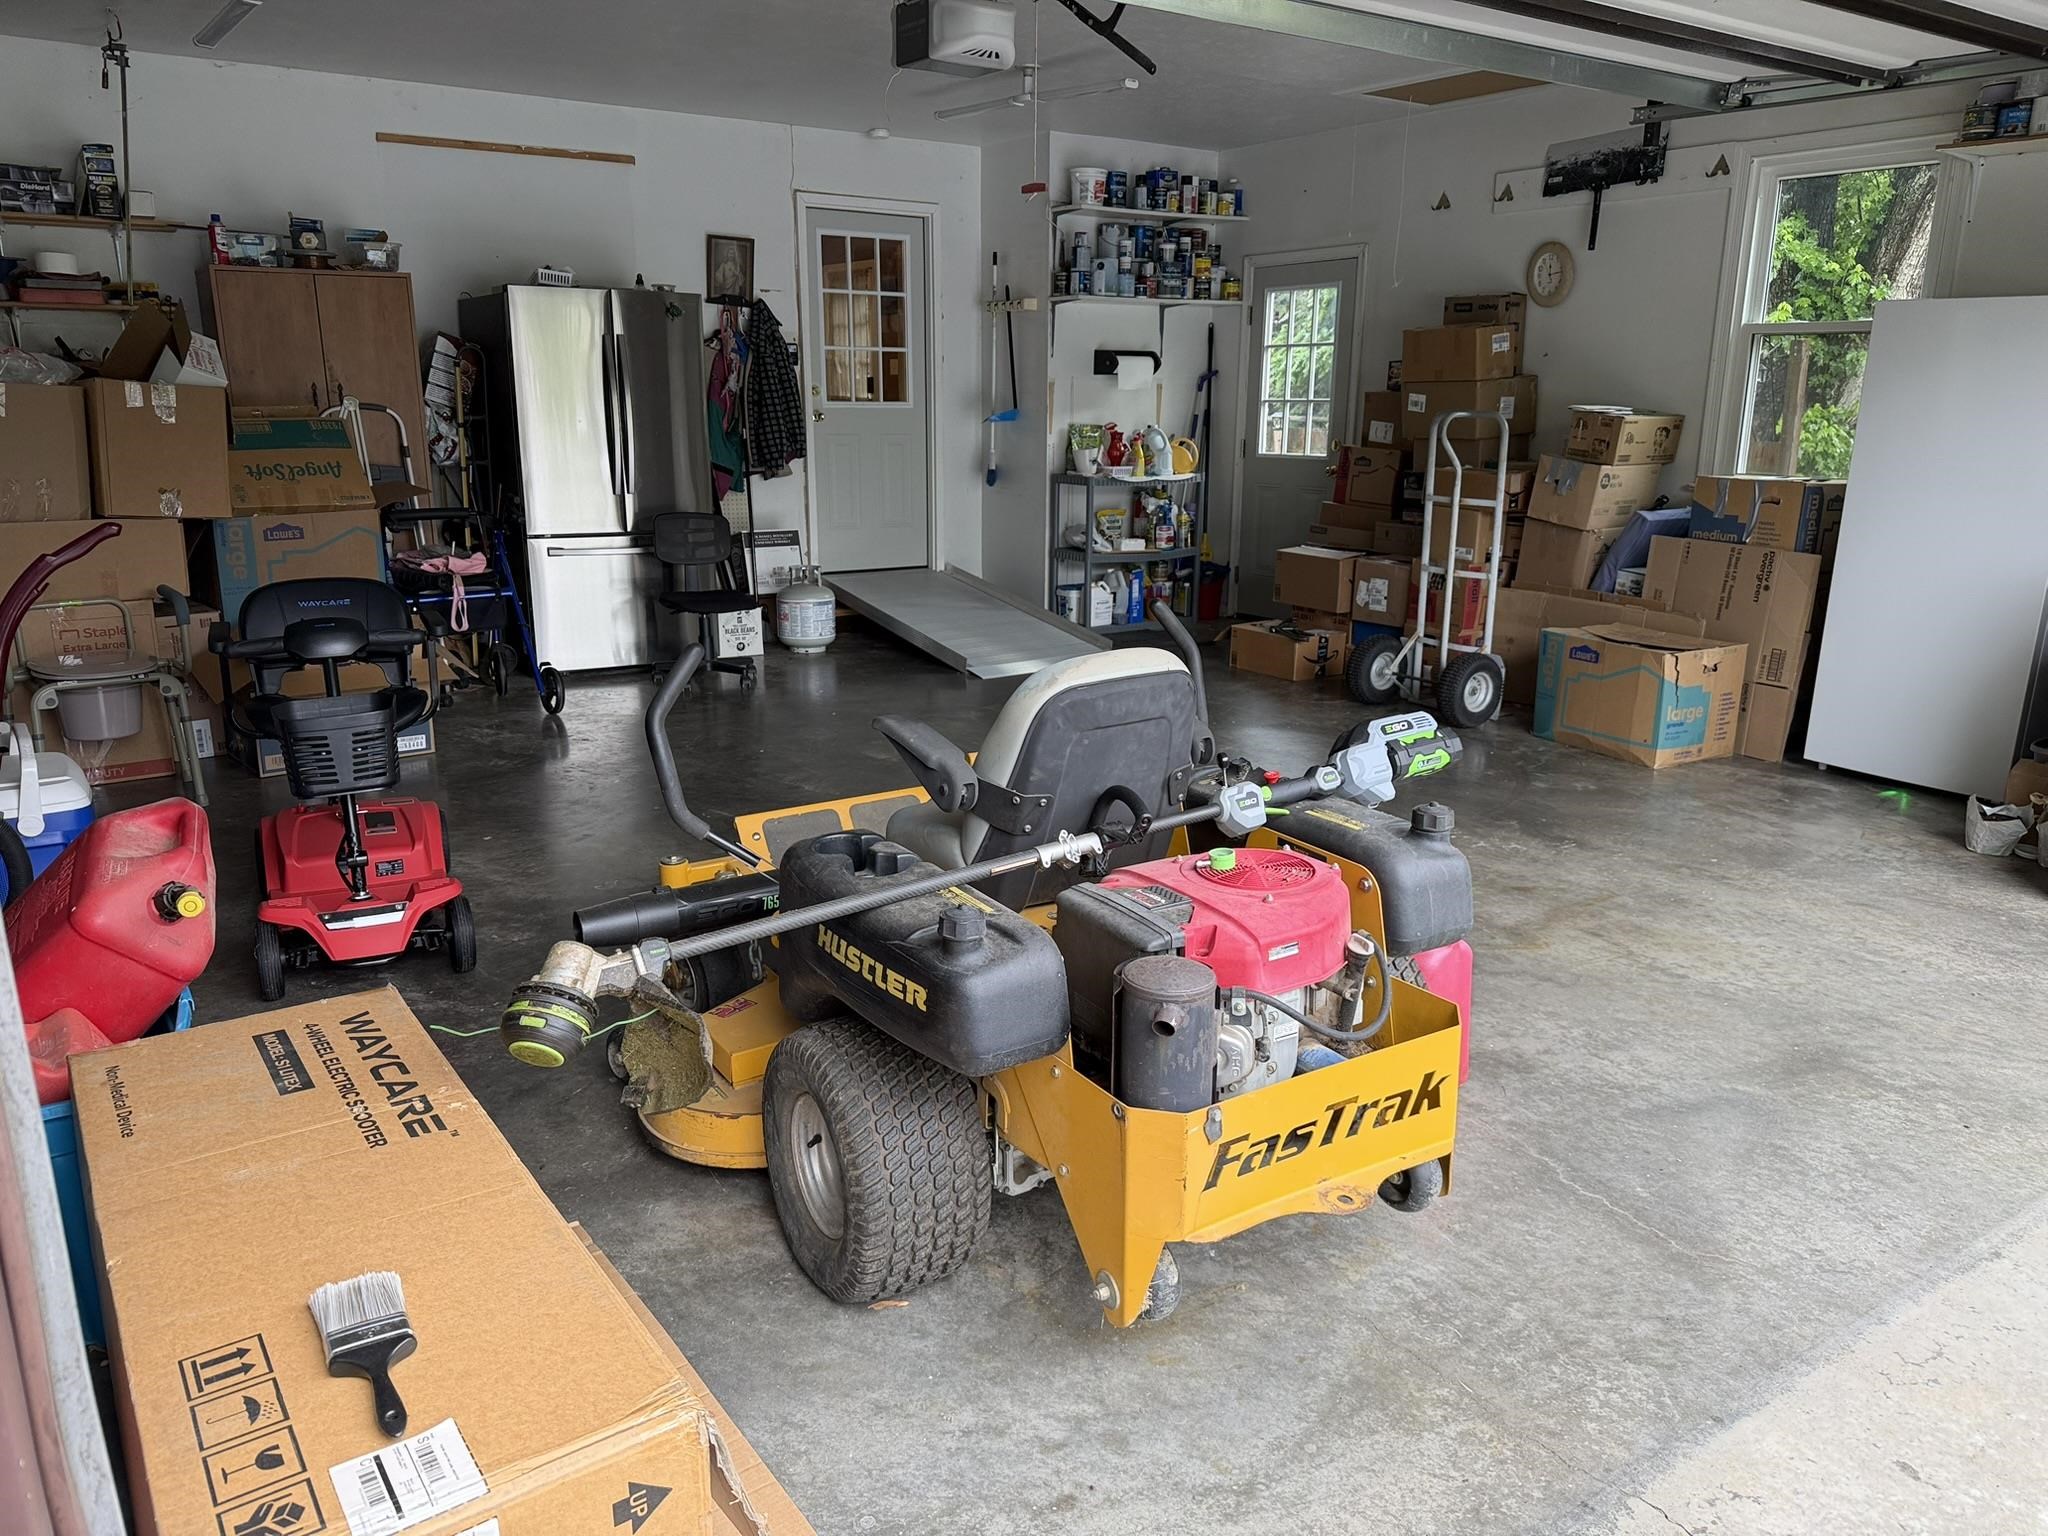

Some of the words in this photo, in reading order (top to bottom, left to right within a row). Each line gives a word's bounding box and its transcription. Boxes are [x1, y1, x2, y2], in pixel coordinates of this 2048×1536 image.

[20, 183, 50, 191] DieHard
[267, 530, 301, 540] LOWE'S
[1692, 529, 1738, 541] medium
[1753, 552, 1769, 603] evergreen
[298, 598, 352, 608] WAYCARE
[83, 625, 136, 640] Staple
[63, 644, 93, 653] Extra
[1666, 704, 1704, 723] large
[1384, 721, 1409, 734] EGO
[1239, 797, 1257, 808] EGO
[762, 895, 780, 911] 765
[817, 923, 929, 1013] HUSTLER
[303, 1023, 335, 1058] 4-WHEEL
[321, 1057, 360, 1099] ELECTRIC
[339, 1010, 448, 1138] WAYCARE
[105, 1065, 132, 1111] Non-Medical
[116, 1110, 137, 1138] Device
[1202, 1070, 1452, 1192] FasTrak
[629, 1489, 648, 1517] UP
